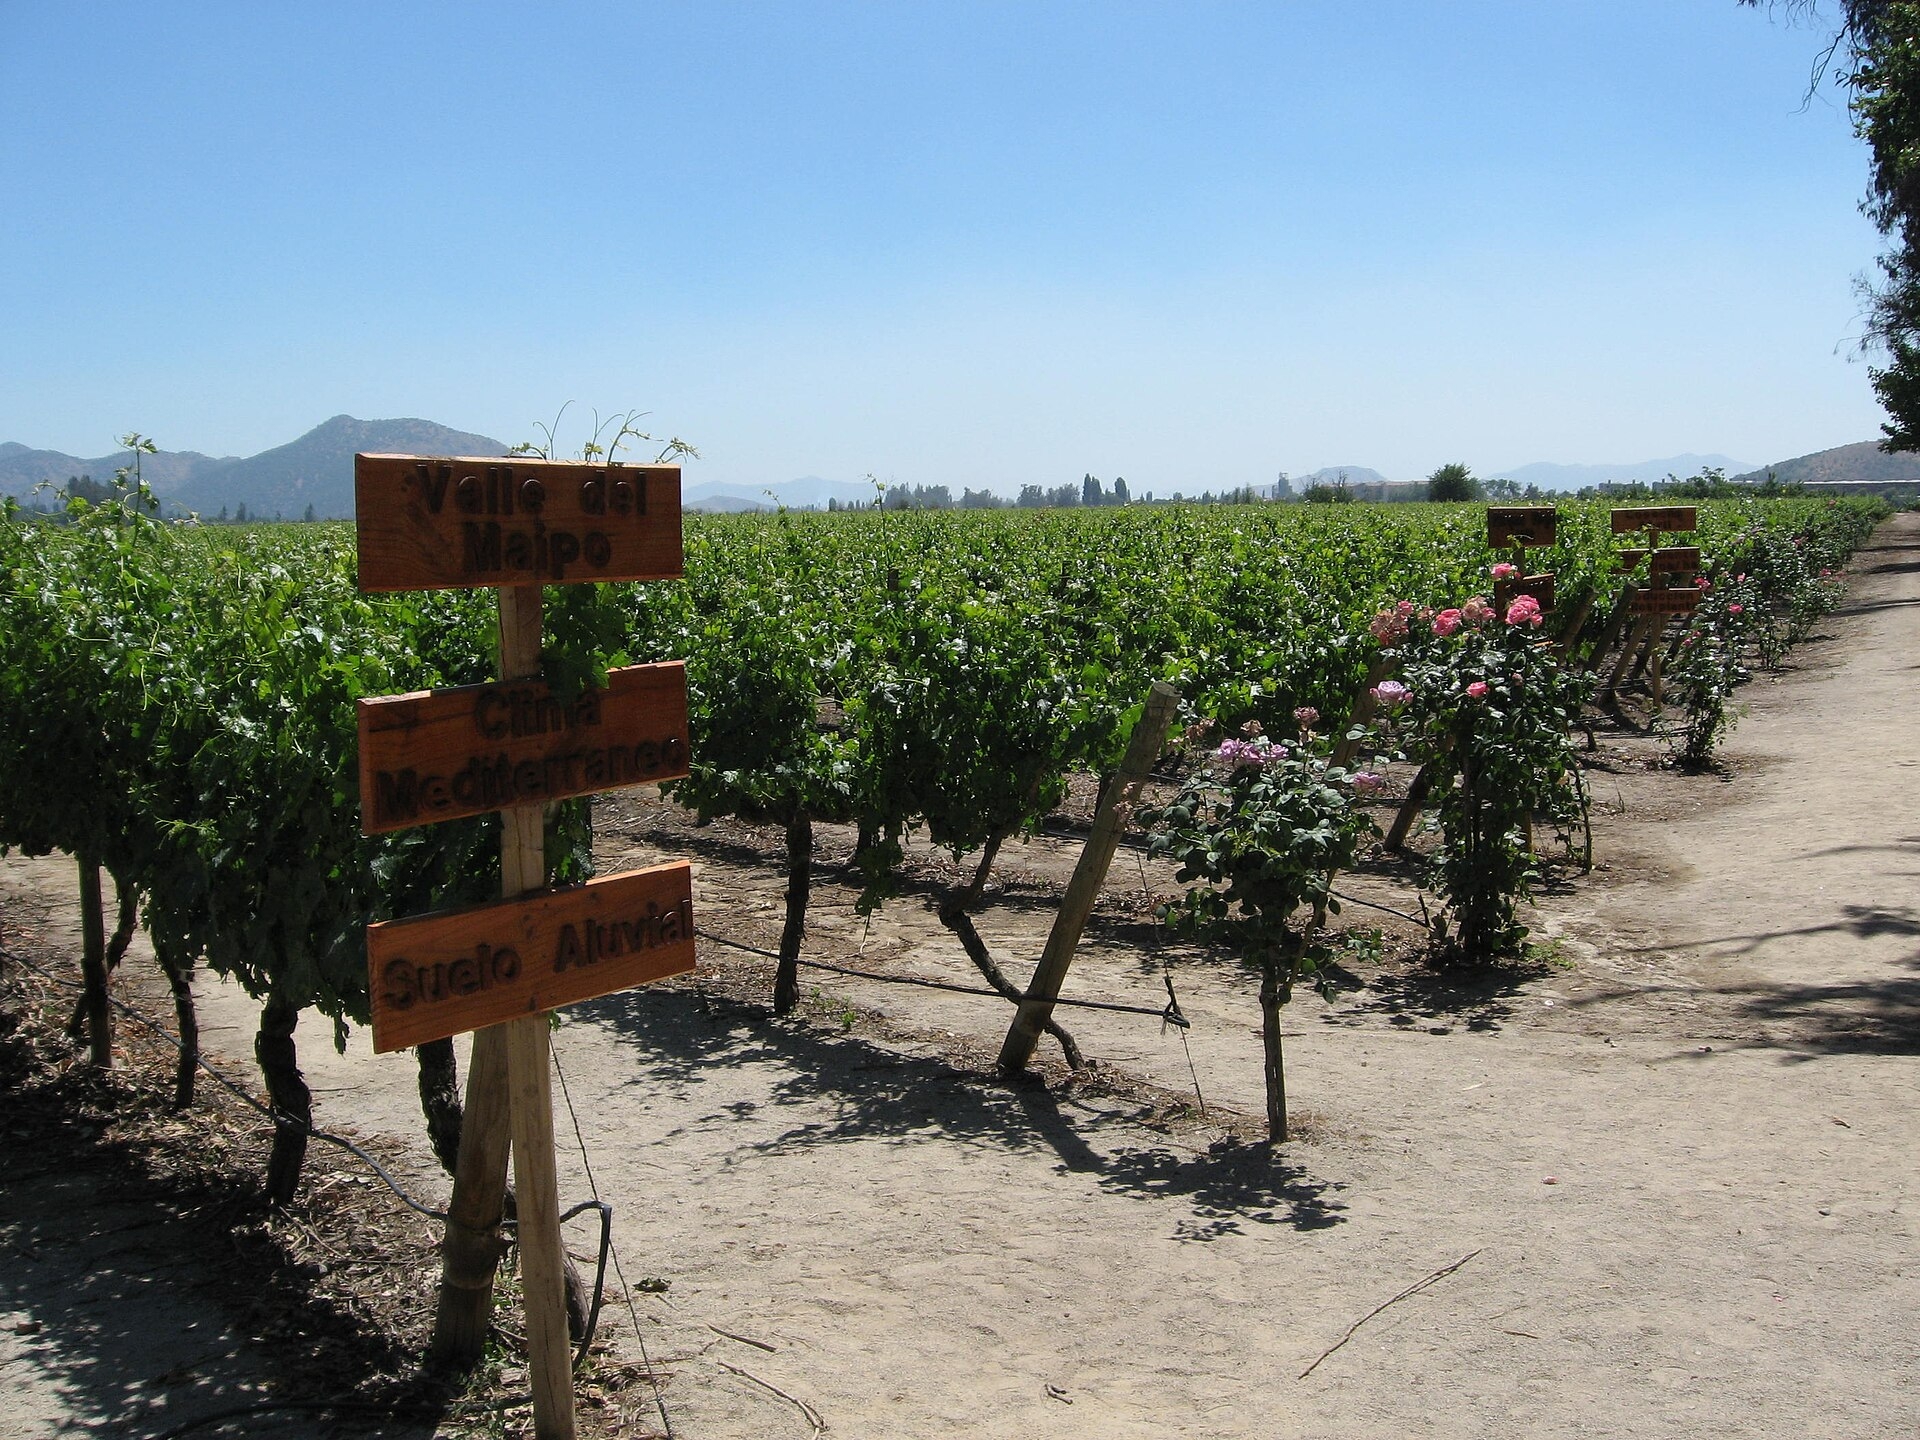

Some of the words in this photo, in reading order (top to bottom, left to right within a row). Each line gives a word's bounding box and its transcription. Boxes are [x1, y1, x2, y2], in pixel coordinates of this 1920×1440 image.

[415, 464, 547, 516] Valle
[578, 469, 648, 517] del
[461, 520, 612, 580] Maipo
[473, 688, 603, 740] Clima
[375, 735, 686, 823] Mediterraneo
[382, 942, 523, 1011] Suelo
[552, 898, 693, 973] Aluvial
